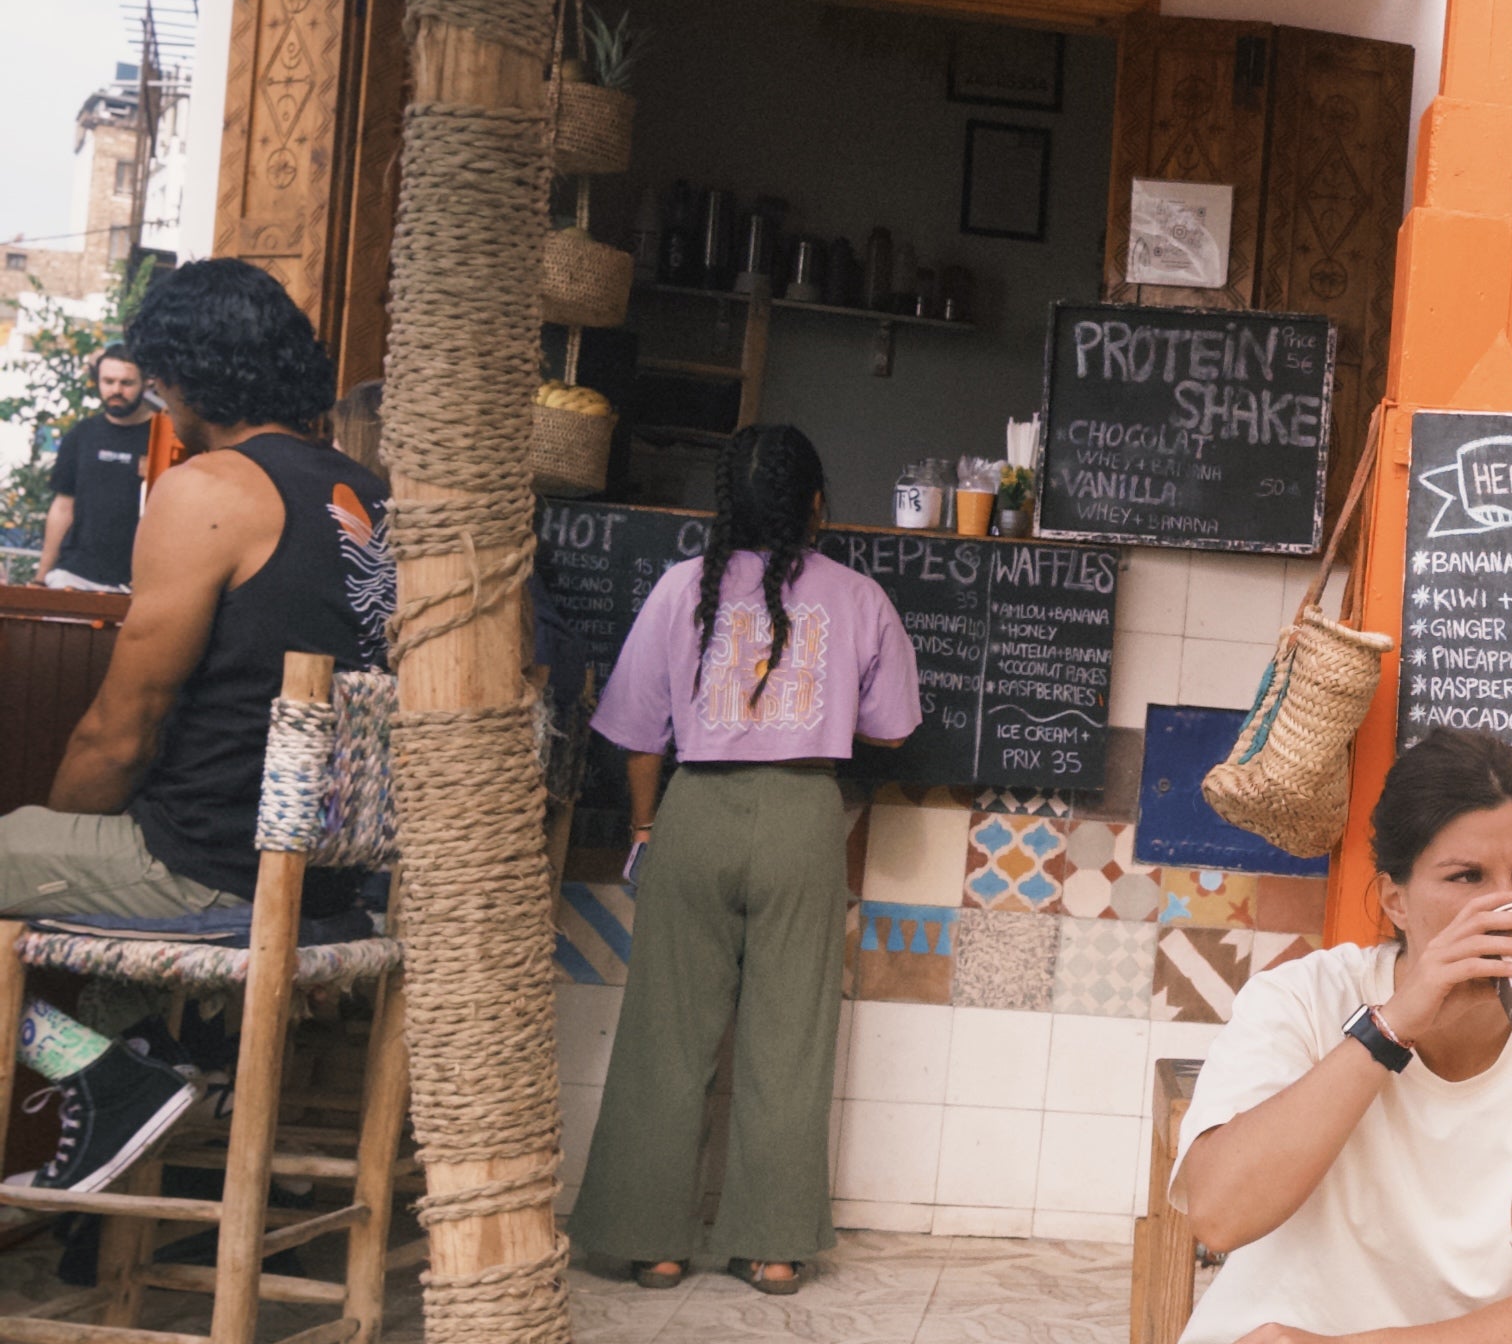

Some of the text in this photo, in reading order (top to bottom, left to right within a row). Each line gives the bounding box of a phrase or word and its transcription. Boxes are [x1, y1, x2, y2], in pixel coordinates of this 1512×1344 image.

[1173, 379, 1321, 447] SHAKE
[1068, 419, 1214, 460] CHOCOLAT
[1076, 449, 1131, 471] WHEY
[1077, 501, 1132, 525] WHEY
[541, 507, 627, 552] HOT
[634, 557, 654, 575] 15
[996, 546, 1116, 594] WAFFLES
[1434, 588, 1487, 611] KIWI
[905, 611, 966, 634] BANANA
[1430, 618, 1507, 641] GINGER
[957, 642, 980, 661] 40
[998, 679, 1096, 707] RASPBERRIES
[942, 707, 967, 729] 40
[997, 724, 1020, 739] ICE
[1025, 725, 1078, 744] CREAM
[1003, 748, 1082, 774] PRIX 35
